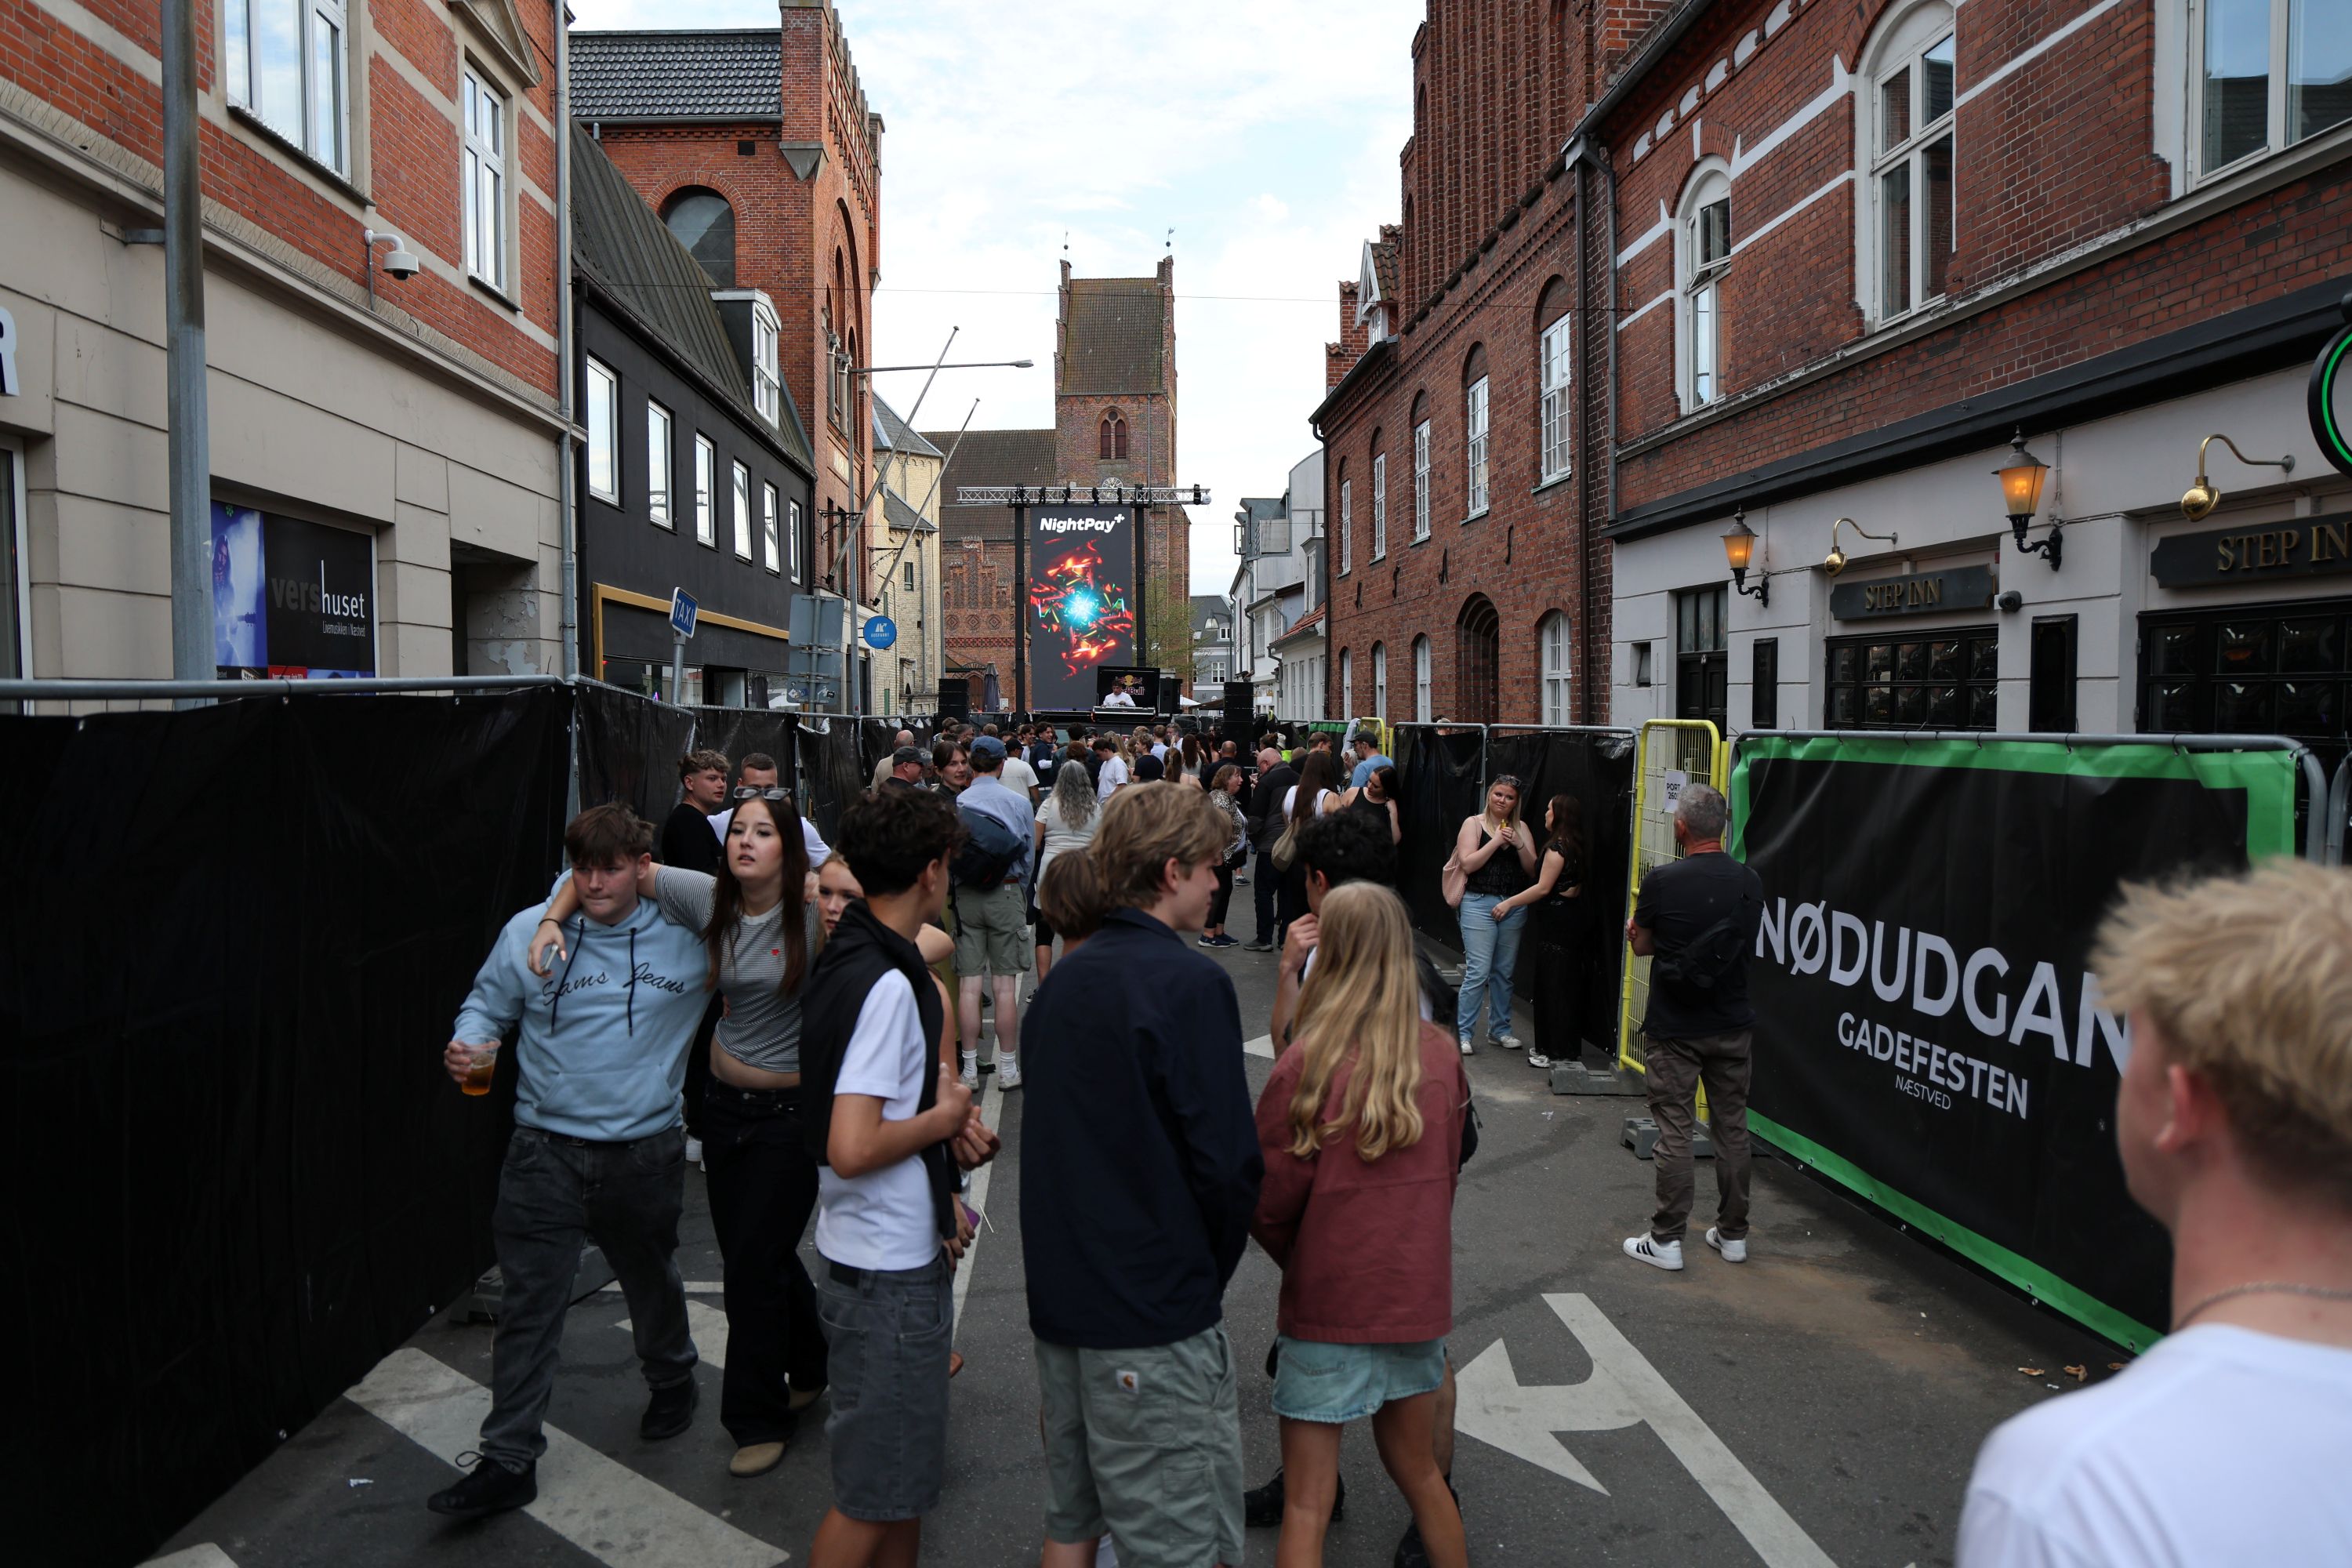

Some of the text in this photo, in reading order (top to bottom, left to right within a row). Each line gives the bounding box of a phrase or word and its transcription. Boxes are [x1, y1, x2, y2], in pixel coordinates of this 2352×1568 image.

[2217, 528, 2300, 572] STEP
[1865, 577, 1943, 609] STEP INN
[675, 597, 695, 628] TAXI
[1666, 782, 1680, 791] PORT
[622, 962, 687, 994] Jeans
[1838, 1012, 2029, 1120] GADEFESTEN
[1895, 1074, 1951, 1110] NÆSTVED
